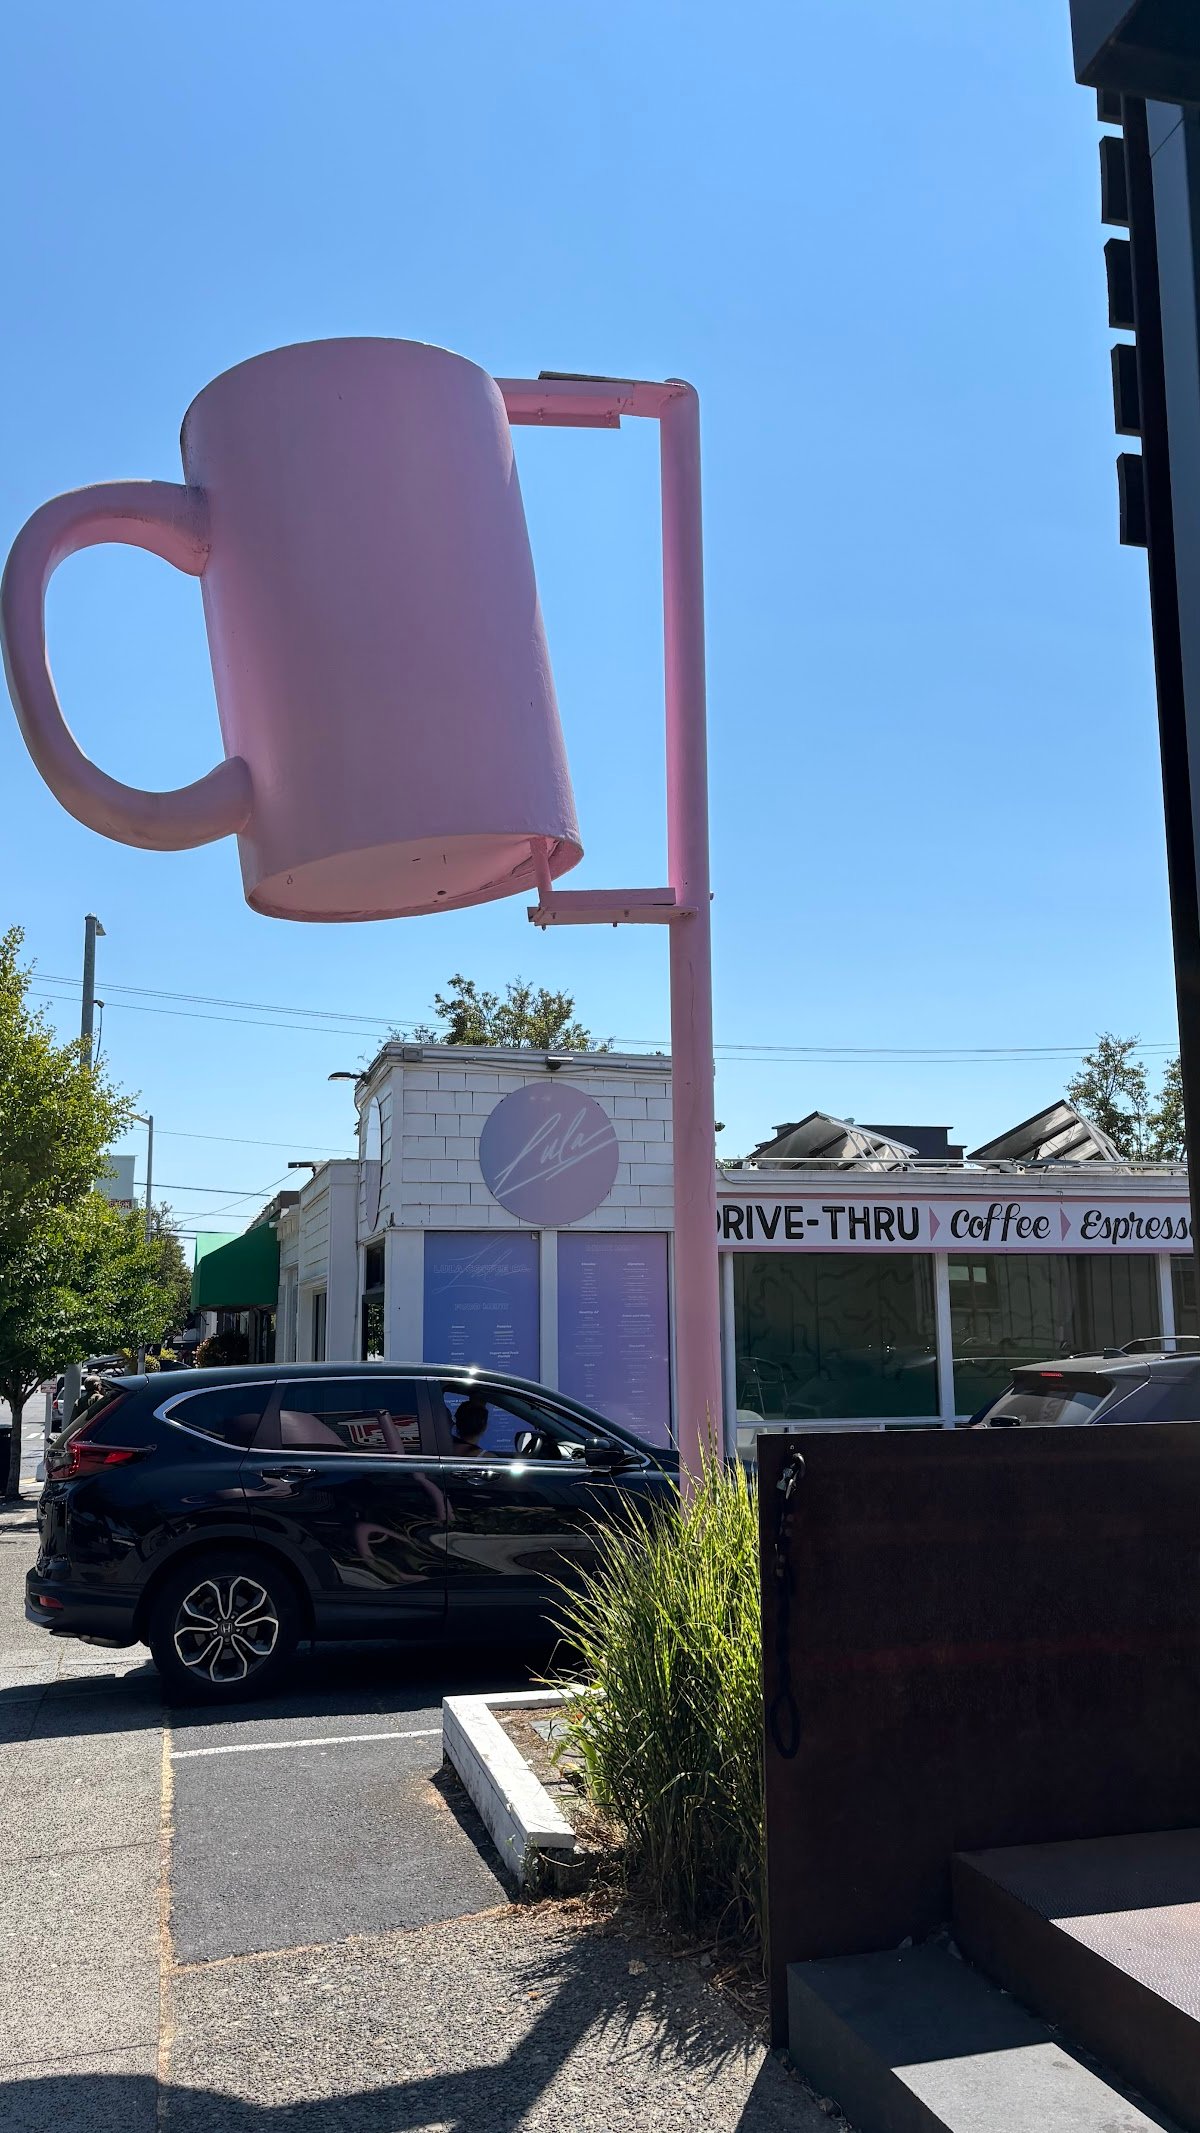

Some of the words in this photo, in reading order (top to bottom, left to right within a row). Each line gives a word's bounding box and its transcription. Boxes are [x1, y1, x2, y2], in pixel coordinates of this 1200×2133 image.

[493, 1107, 617, 1199] Lula
[717, 1205, 919, 1241] RIVE-THRU
[950, 1203, 1050, 1241] Coffee
[1080, 1209, 1194, 1244] Espress
